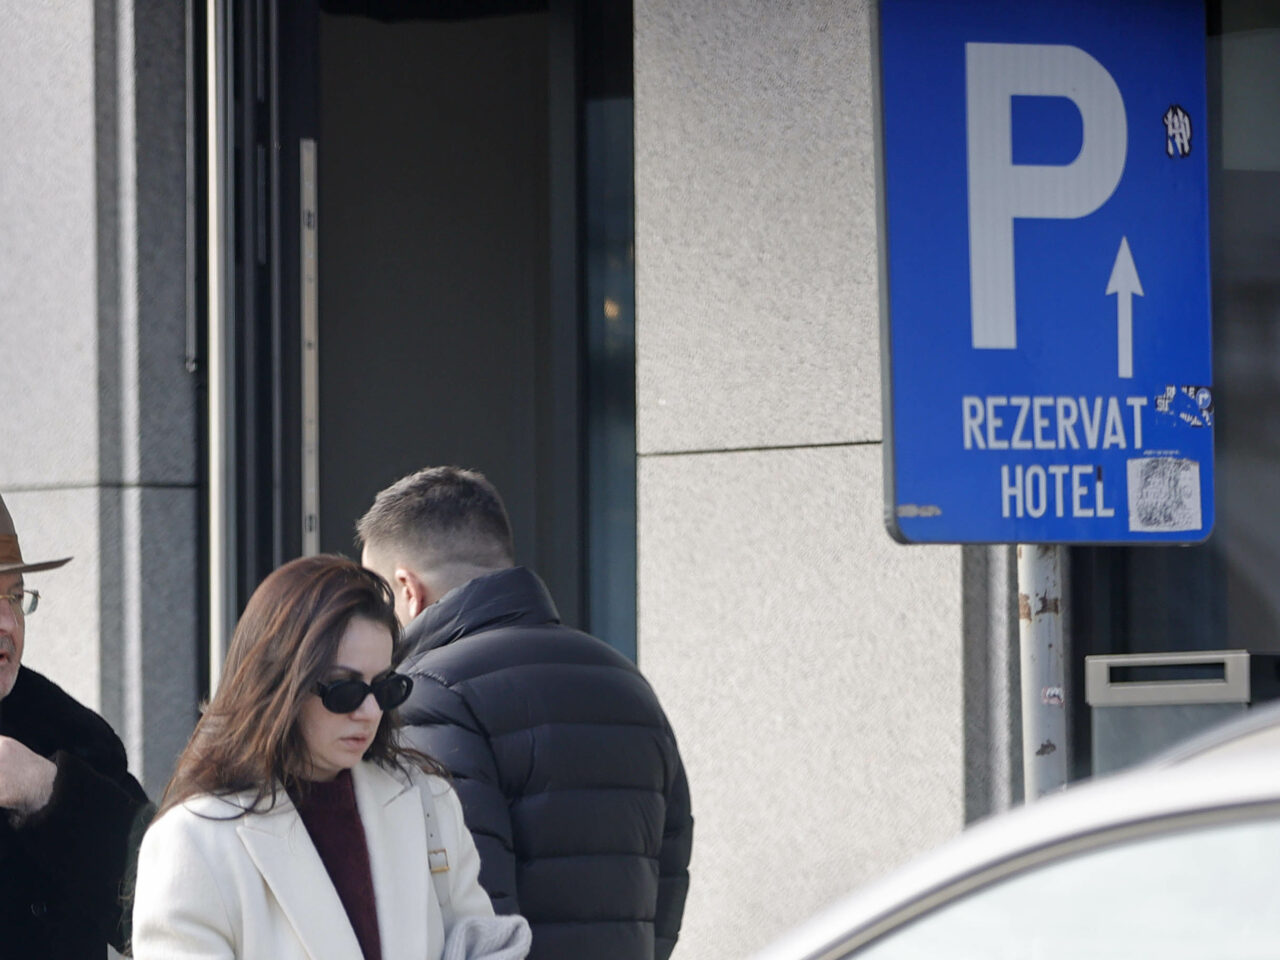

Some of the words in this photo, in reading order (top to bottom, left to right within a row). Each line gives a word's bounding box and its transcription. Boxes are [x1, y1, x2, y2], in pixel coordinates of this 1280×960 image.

[965, 42, 1128, 350] P
[963, 396, 1147, 449] REZERVAT
[1002, 465, 1114, 518] HOTEL
